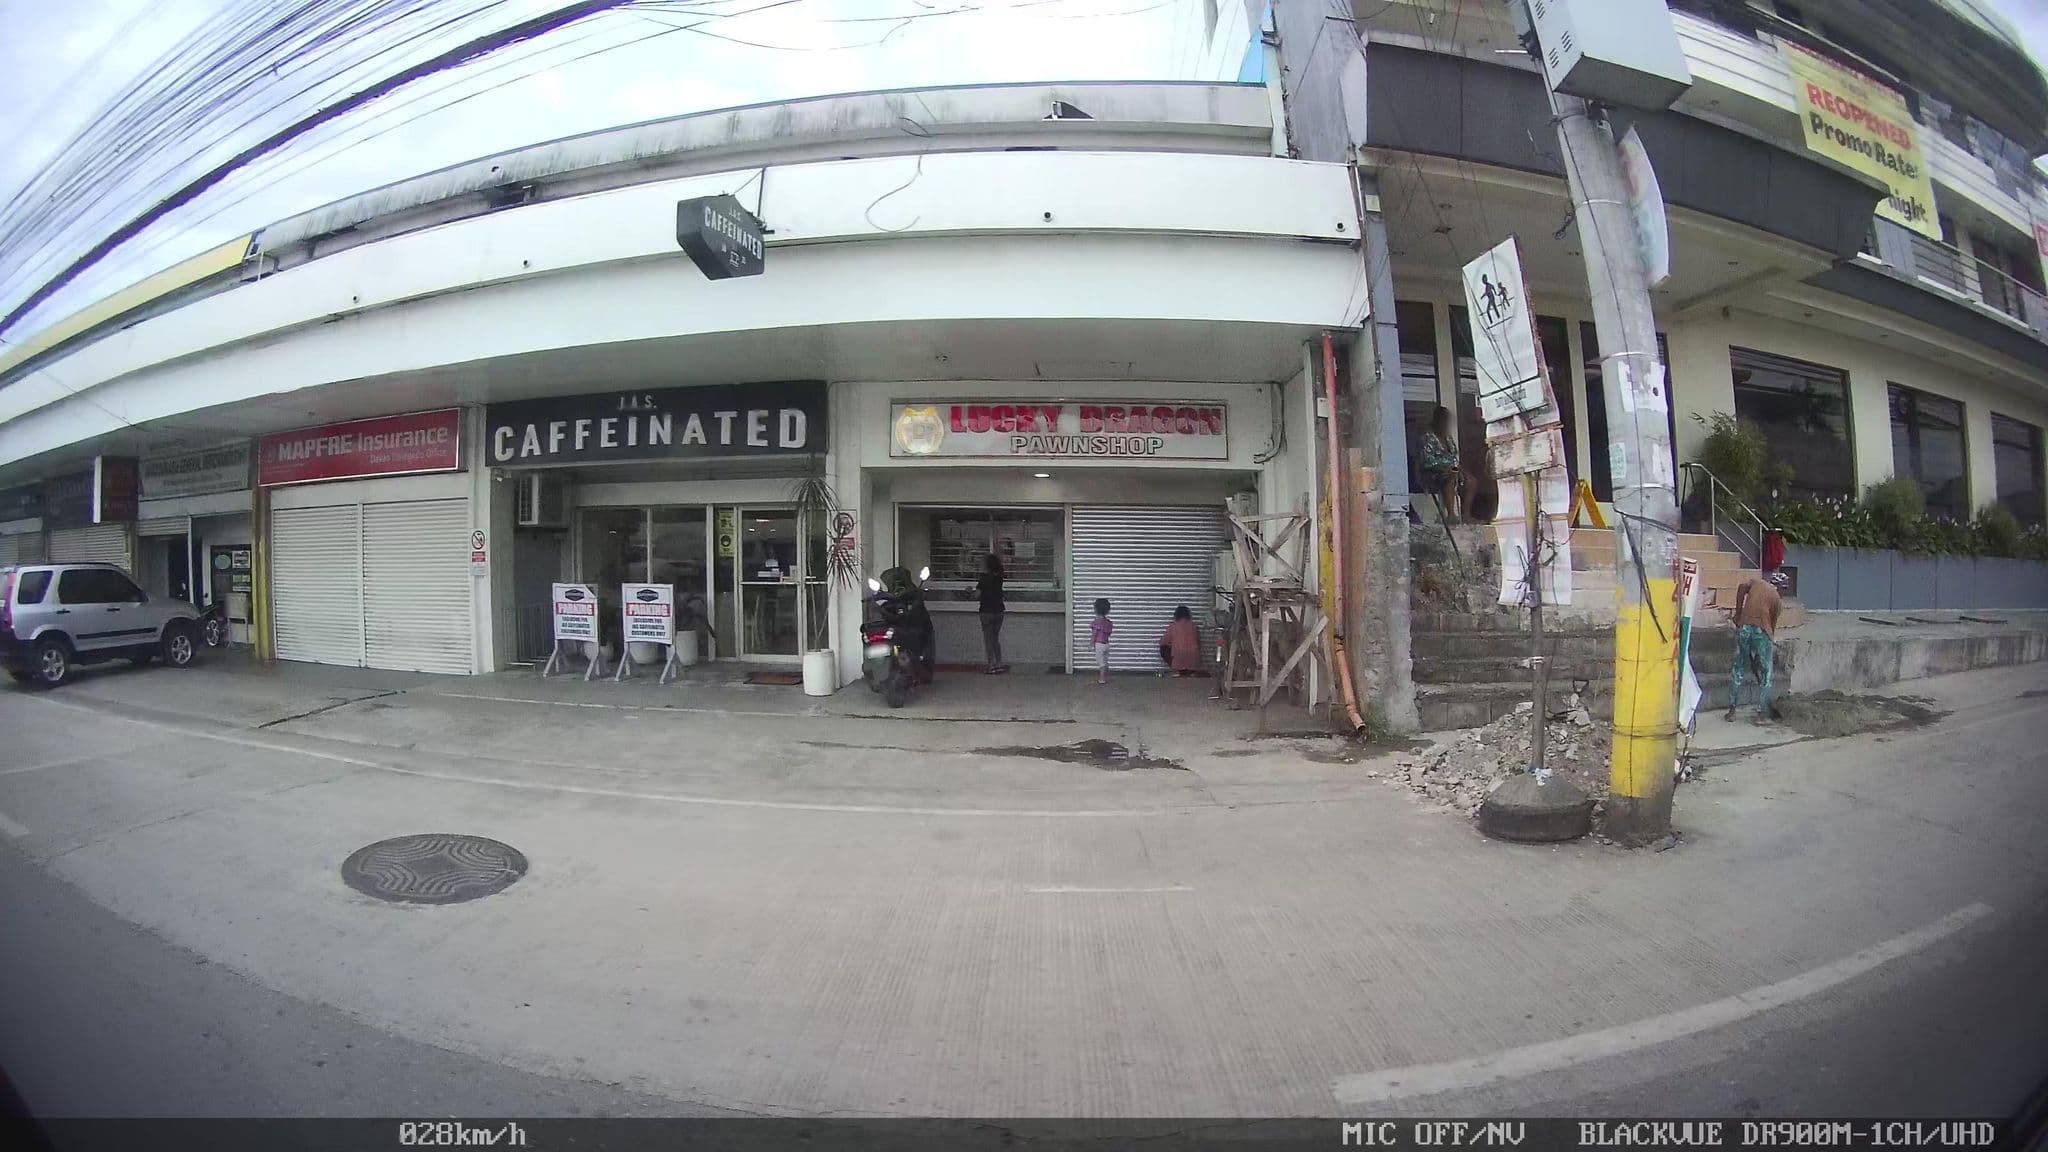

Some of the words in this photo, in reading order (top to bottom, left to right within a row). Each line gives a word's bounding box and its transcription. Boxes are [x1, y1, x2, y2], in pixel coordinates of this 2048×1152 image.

[1806, 82, 1913, 150] REOPENED
[1809, 111, 1872, 158] Promo
[704, 205, 763, 260] CAFFEINATED
[494, 408, 807, 461] CAFFEINATED
[950, 405, 1064, 433] LUCKY
[1079, 405, 1222, 435] DRAGON
[279, 433, 353, 461] MAPFRE
[358, 426, 448, 453] Insurance
[1010, 434, 1164, 455] PAWNSHOP
[628, 603, 668, 616] PARKING
